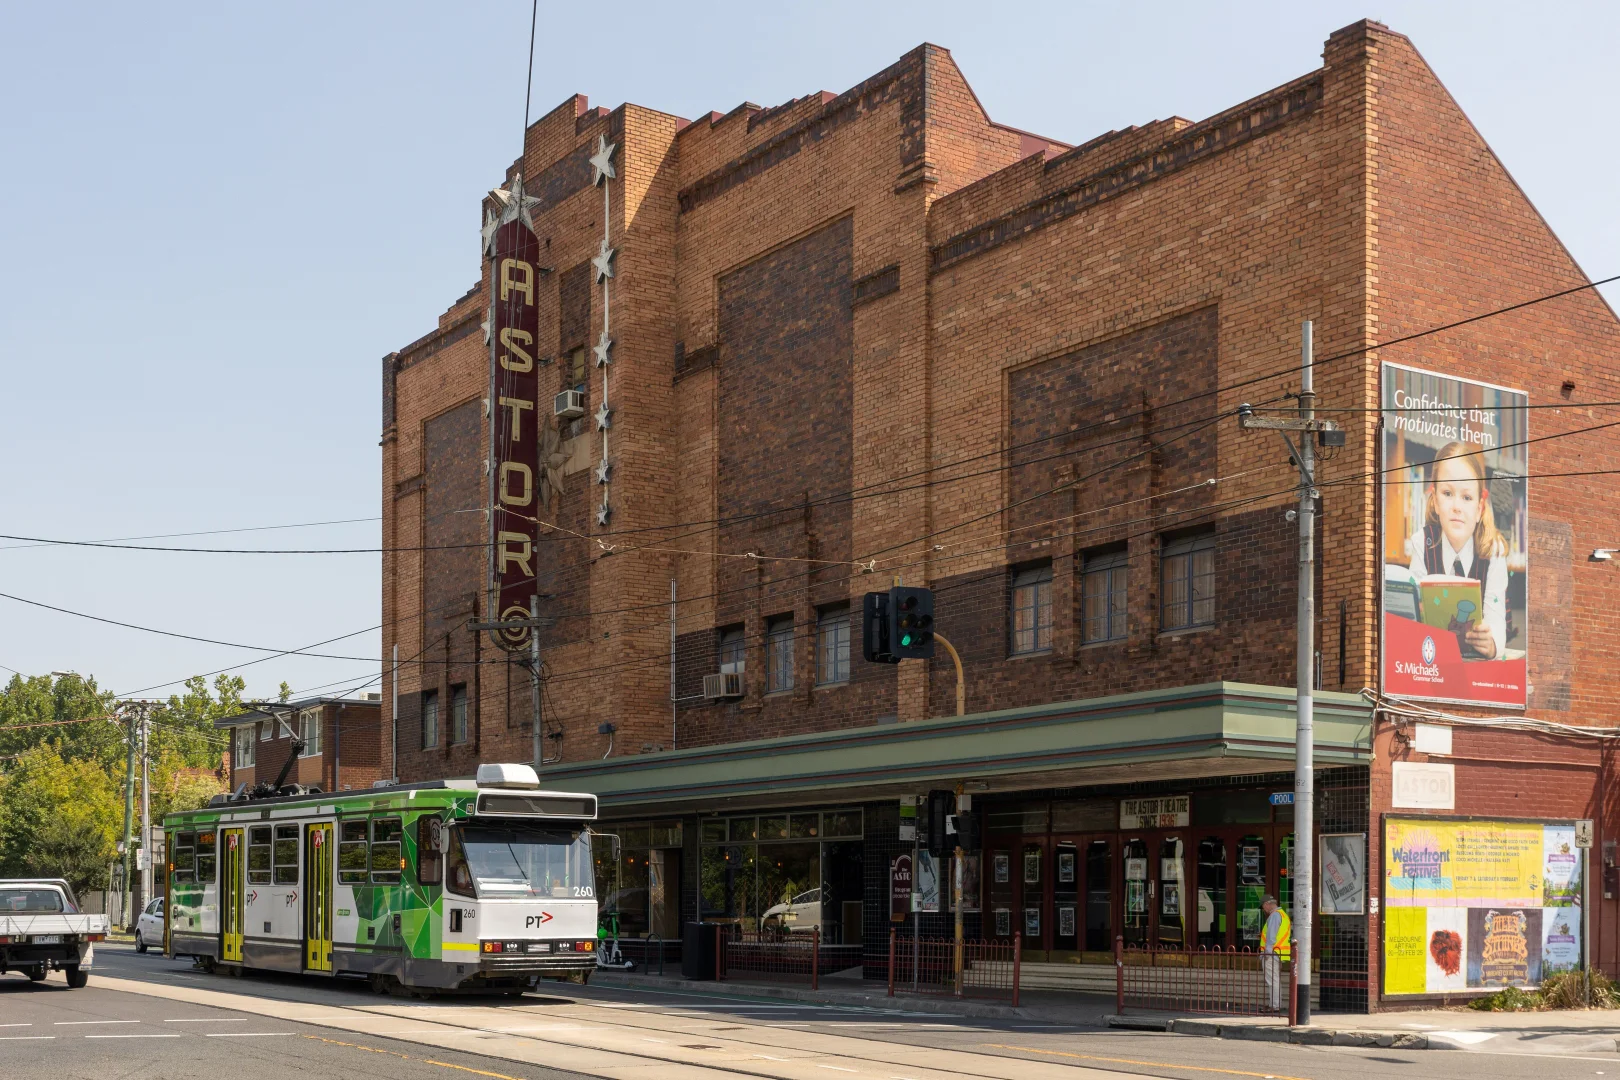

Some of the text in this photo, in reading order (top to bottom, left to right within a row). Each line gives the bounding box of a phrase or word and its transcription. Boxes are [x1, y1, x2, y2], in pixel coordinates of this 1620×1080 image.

[1394, 389, 1496, 426] Confidence that
[499, 257, 534, 577] ASTOR
[1394, 415, 1496, 447] motivates them.
[1395, 660, 1439, 677] St Michael's
[1402, 776, 1448, 794] ASTOR
[1125, 798, 1188, 815] THE ASTOR THEATRE
[1274, 794, 1292, 803] POOL
[1392, 847, 1450, 863] Waterfront
[1402, 862, 1442, 879] Festival
[573, 886, 593, 897] 260
[463, 908, 476, 919] 260
